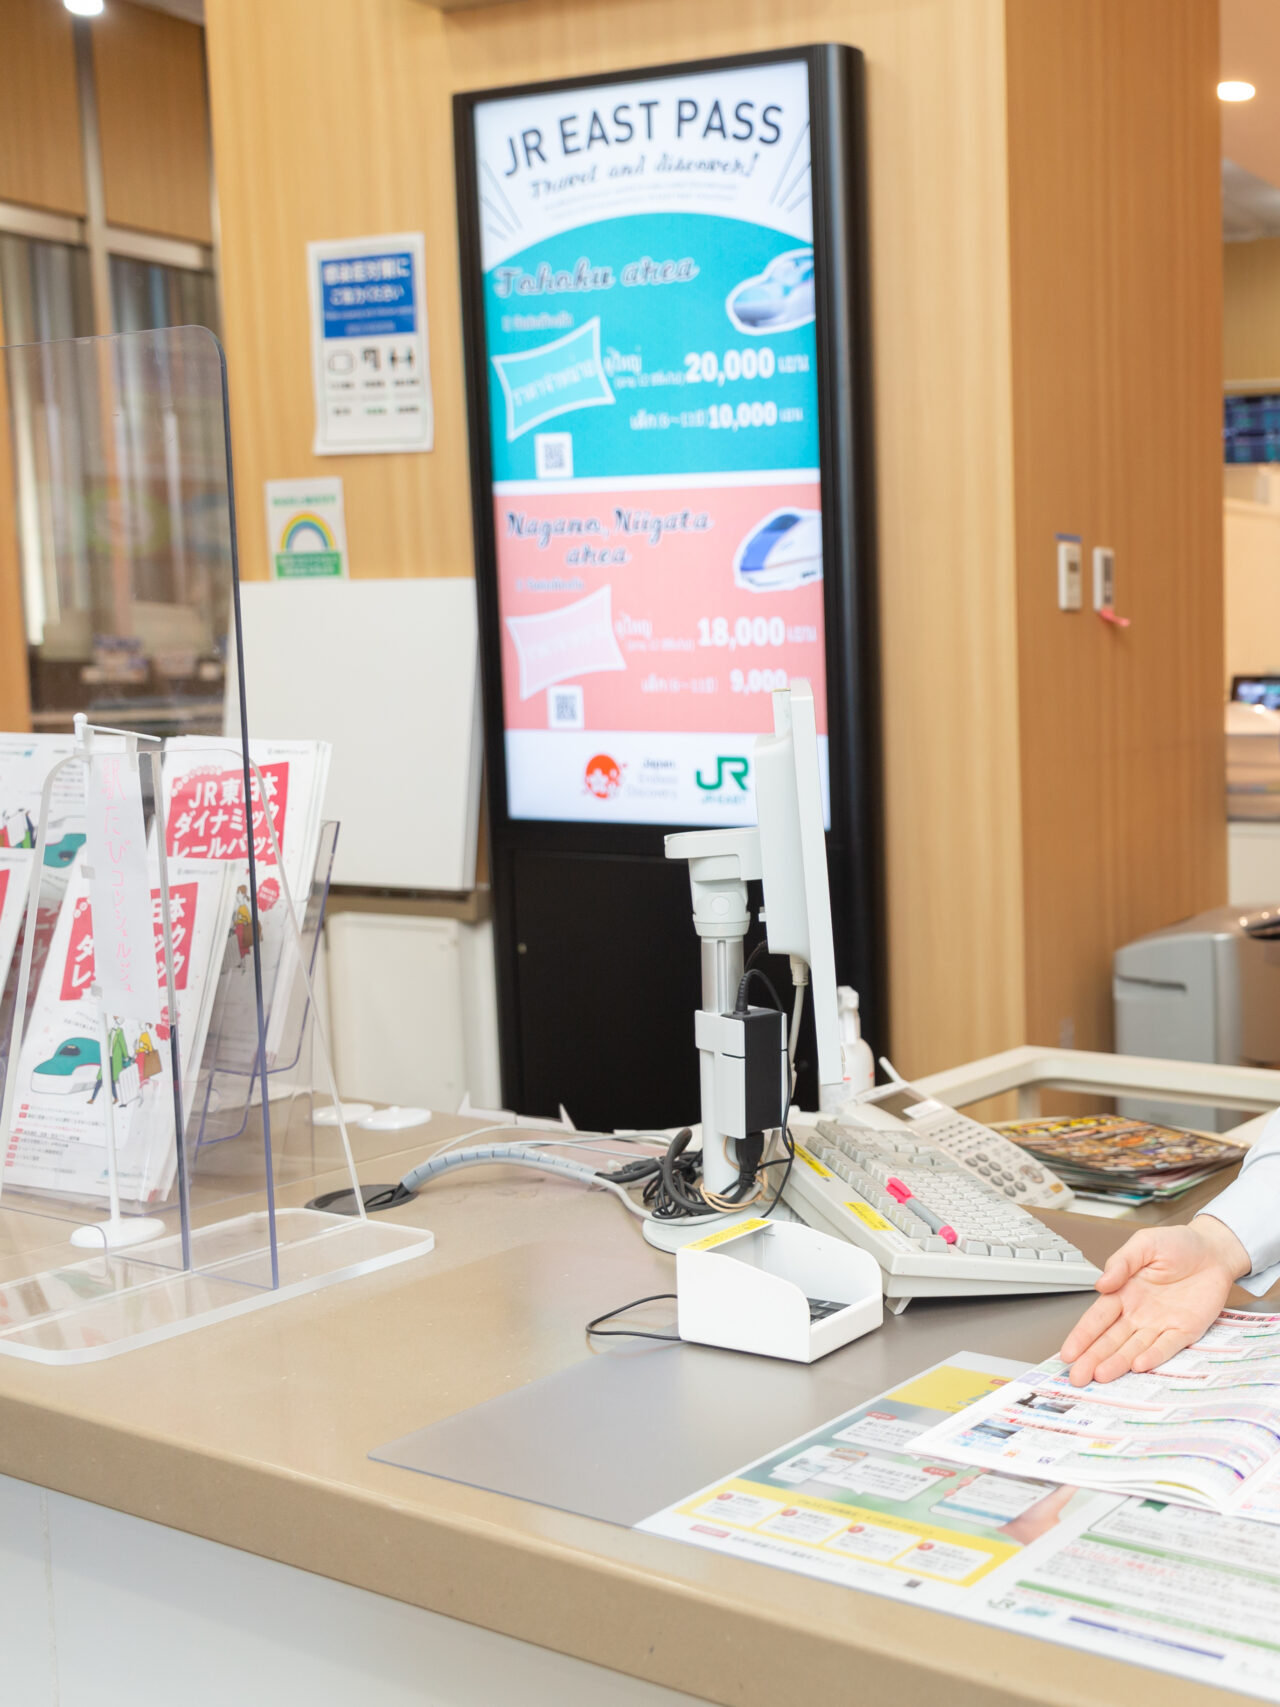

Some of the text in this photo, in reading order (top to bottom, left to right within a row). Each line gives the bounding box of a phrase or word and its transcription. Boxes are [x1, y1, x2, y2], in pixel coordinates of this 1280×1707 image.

[504, 99, 784, 177] JR EAST PASS
[531, 166, 597, 198] Travel
[608, 154, 645, 178] and
[495, 256, 697, 296] Tohoku area
[684, 347, 775, 387] 20,000
[708, 401, 778, 432] 10,000
[614, 508, 712, 543] Niigata
[566, 544, 629, 566] area
[697, 616, 786, 652] 18,000
[729, 668, 788, 696] 9,000
[188, 771, 279, 808] JR東日本
[696, 757, 749, 790] JR
[174, 800, 280, 839] ダイナミック
